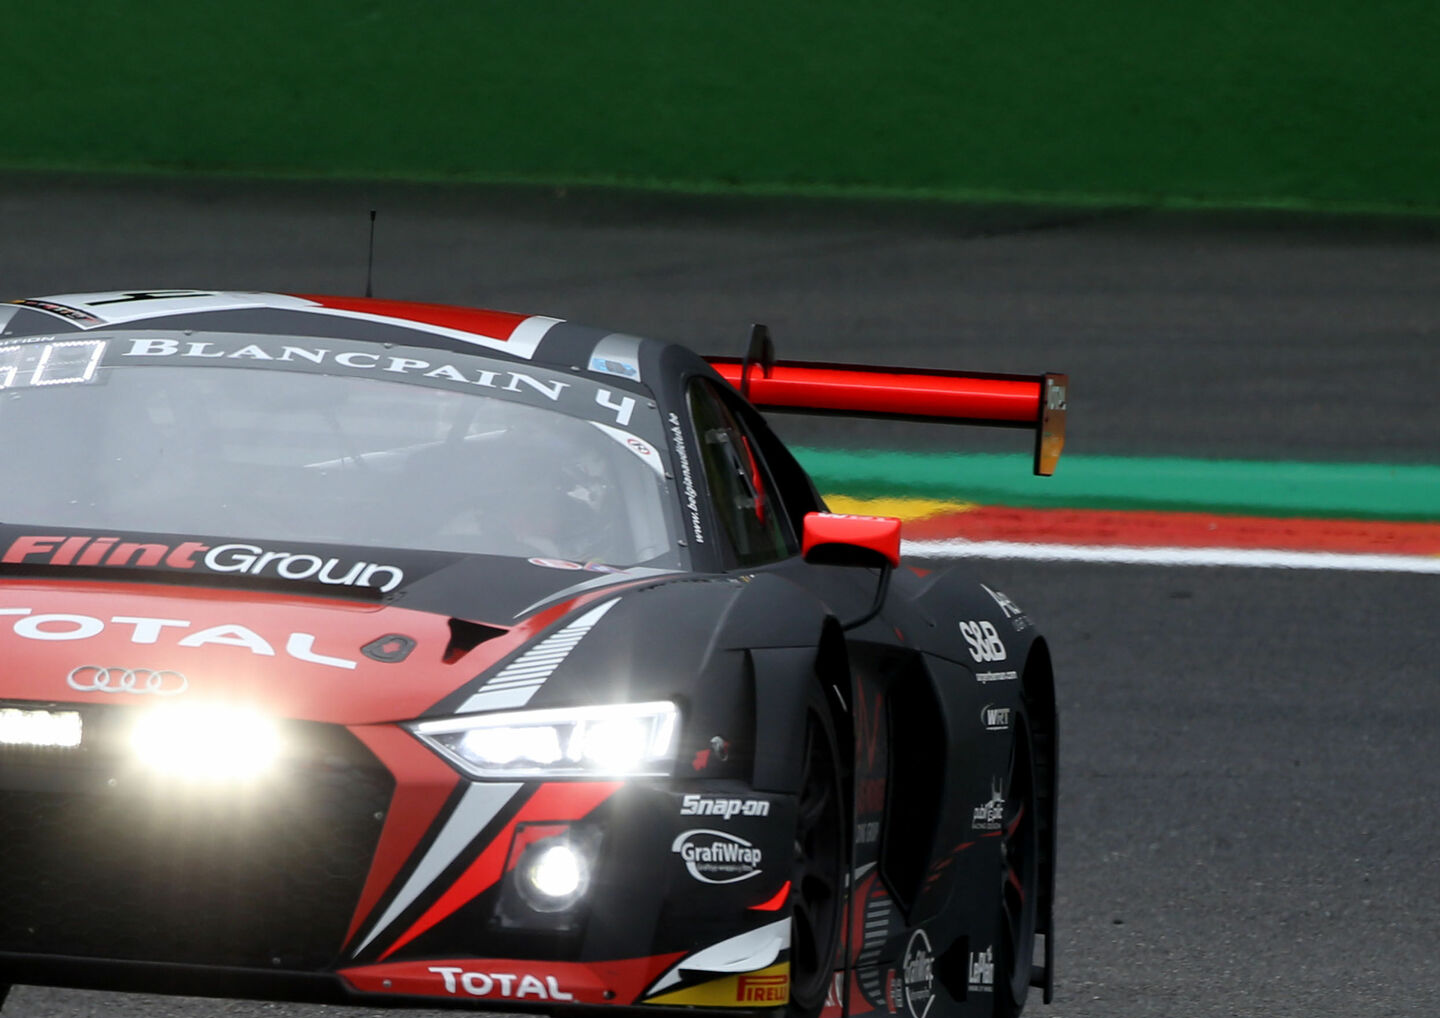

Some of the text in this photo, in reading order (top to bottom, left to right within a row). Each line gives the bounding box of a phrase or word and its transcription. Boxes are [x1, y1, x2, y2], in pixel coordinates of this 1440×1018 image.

[121, 338, 570, 401] BLANCPAIN
[595, 388, 636, 426] 4
[959, 620, 1007, 663] S&B
[987, 708, 1010, 726] WRT
[680, 794, 770, 820] Snap-on
[681, 841, 762, 868] GrafiWrap
[427, 966, 574, 1000] TOTAL
